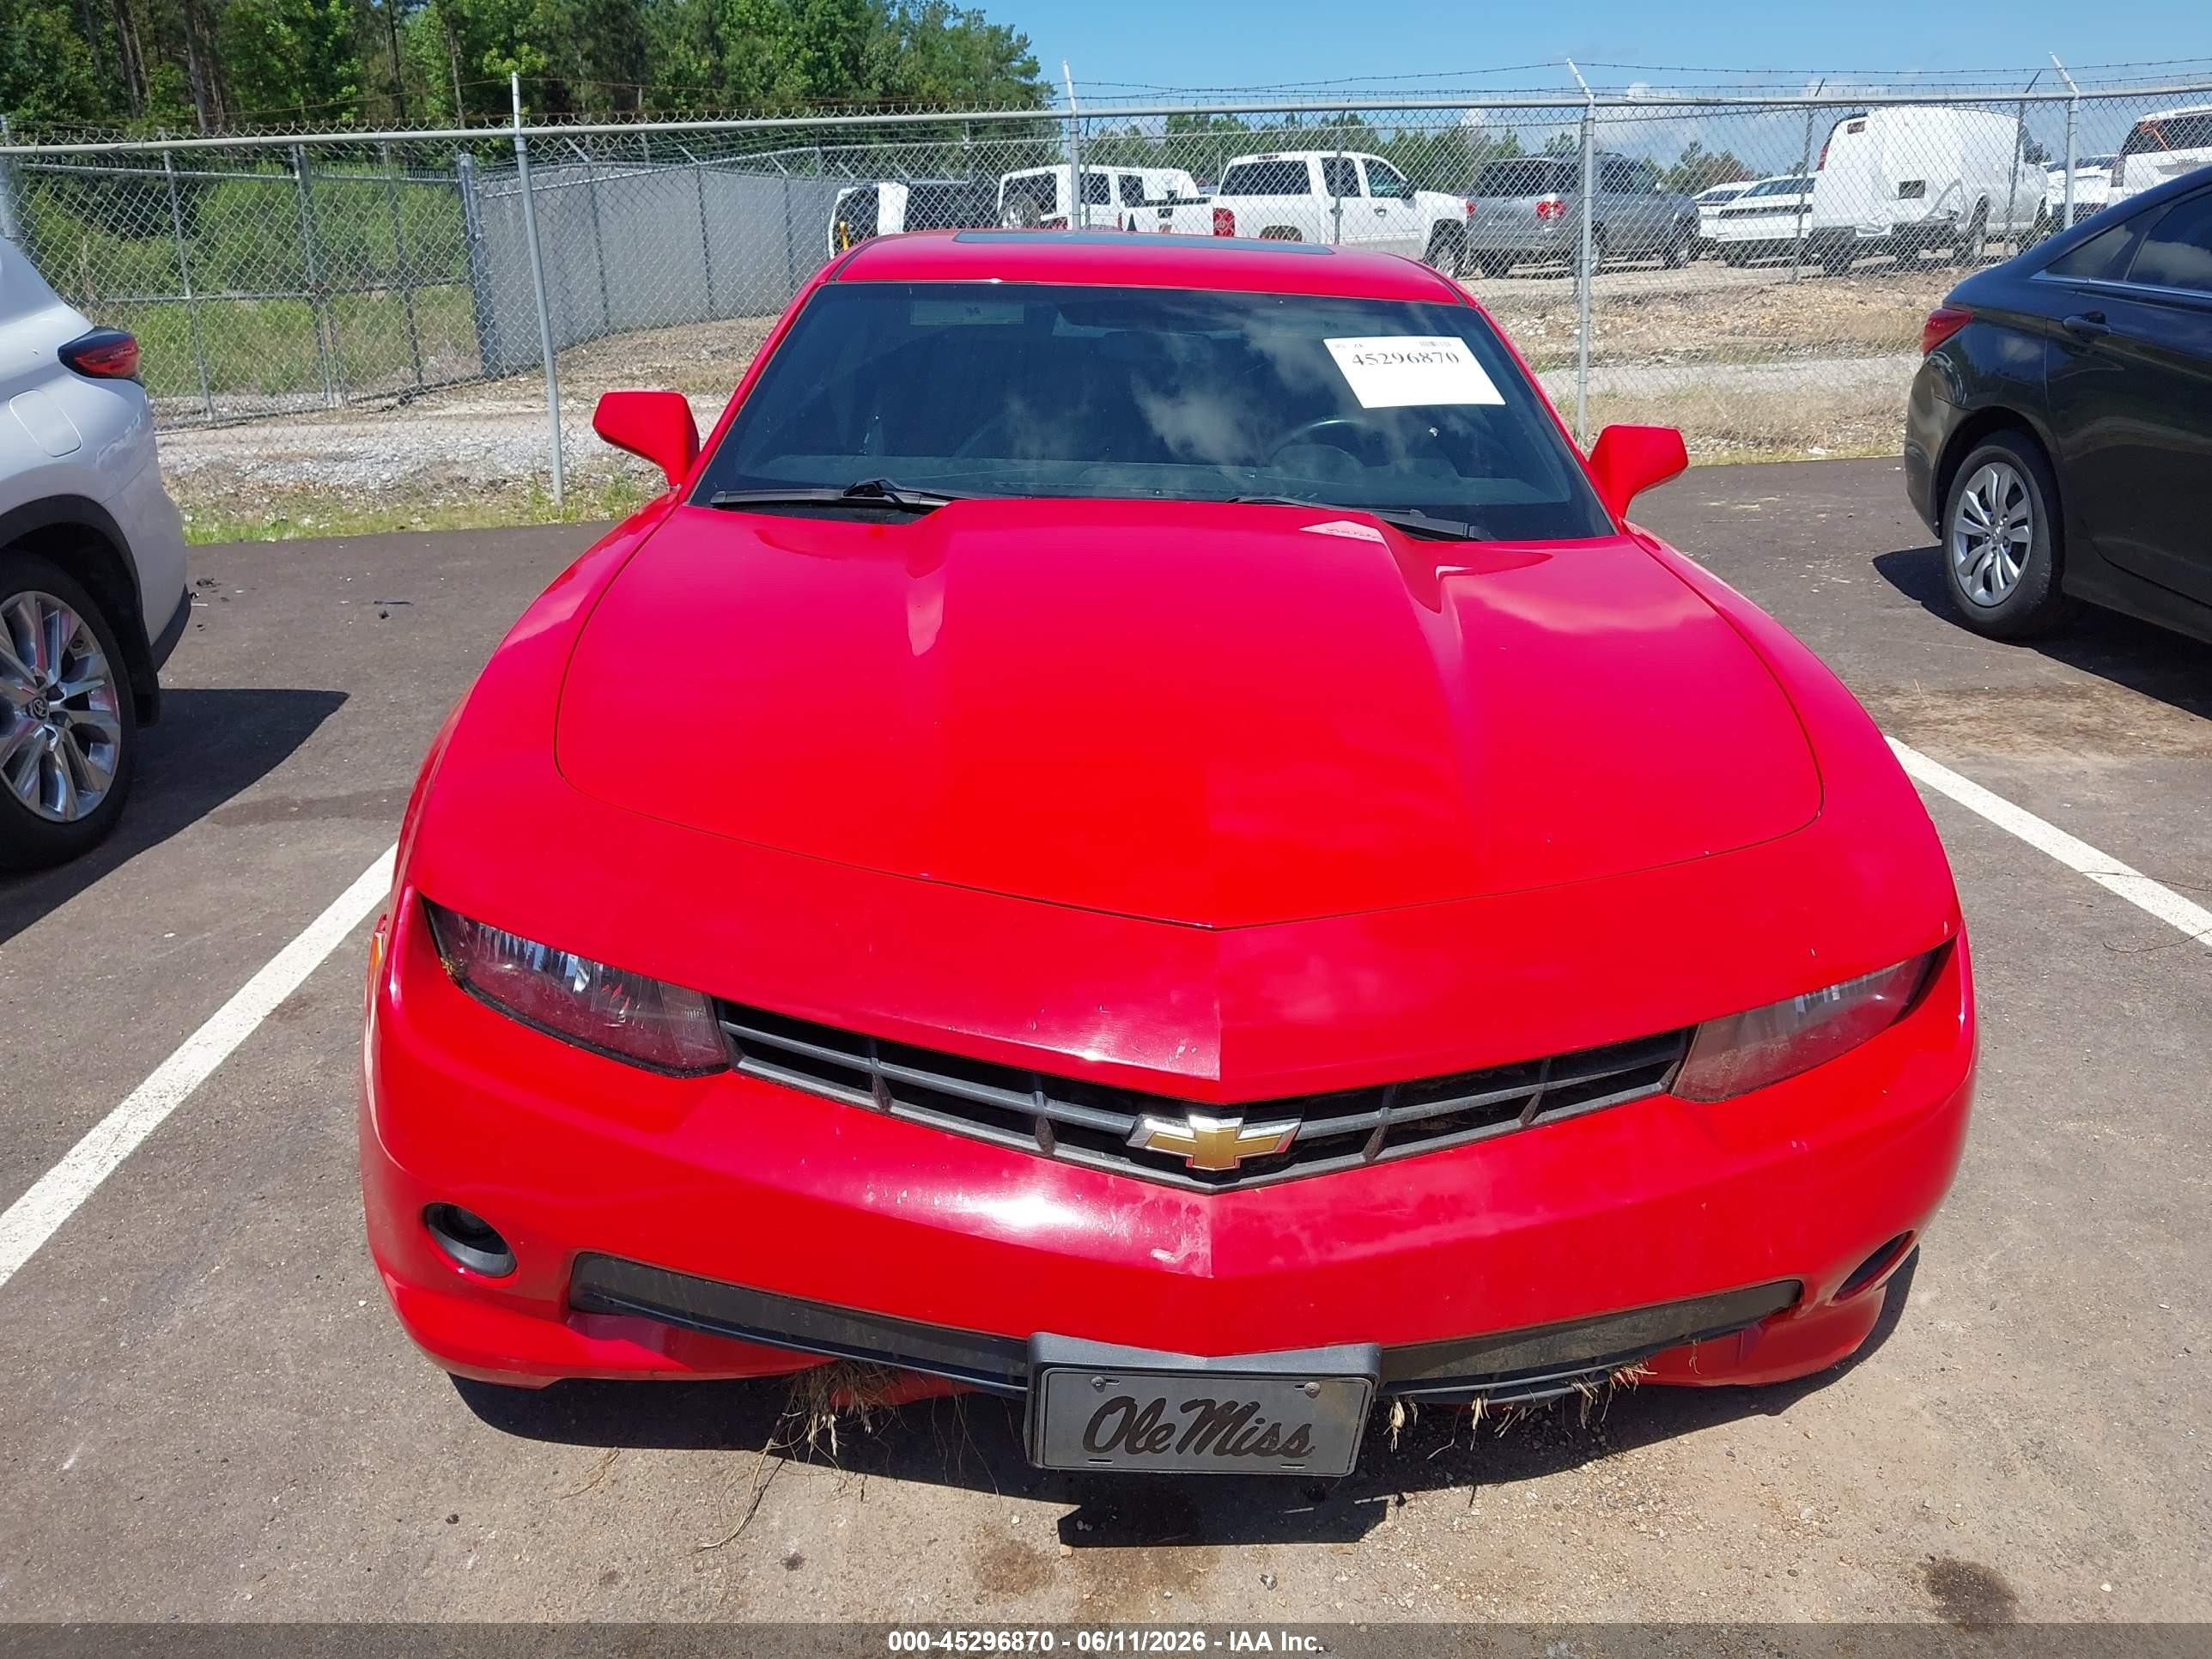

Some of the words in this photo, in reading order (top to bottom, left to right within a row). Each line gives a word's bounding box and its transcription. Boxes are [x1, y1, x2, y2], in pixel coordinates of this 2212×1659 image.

[1352, 351, 1460, 366] 45296870
[1082, 1395, 1175, 1455] Ole
[1174, 1398, 1316, 1459] Miss
